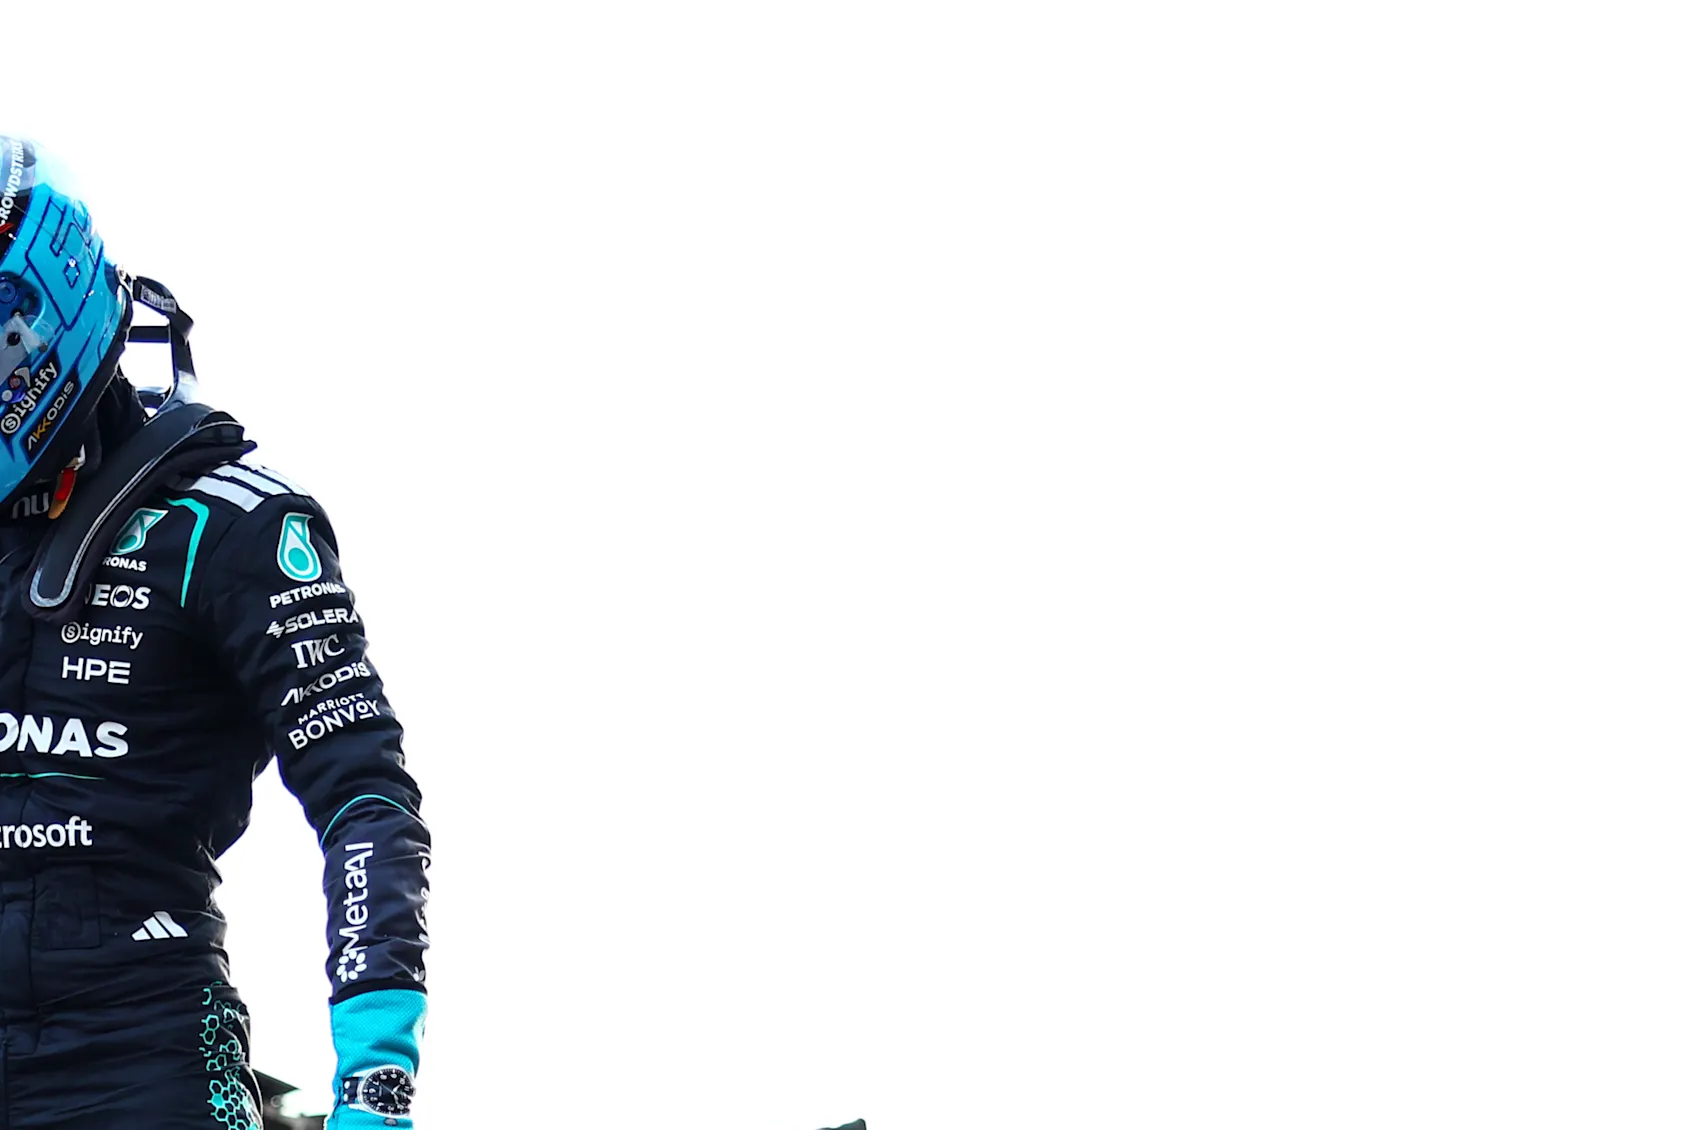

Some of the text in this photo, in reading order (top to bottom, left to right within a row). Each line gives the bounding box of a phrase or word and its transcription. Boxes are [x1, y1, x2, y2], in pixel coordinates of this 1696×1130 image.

[87, 583, 151, 610] EOS
[284, 607, 359, 634] SOLERA
[291, 634, 345, 669] IWC
[62, 656, 131, 684] HPE
[297, 692, 364, 725] MARRIOTT
[288, 699, 380, 750] BONVOY
